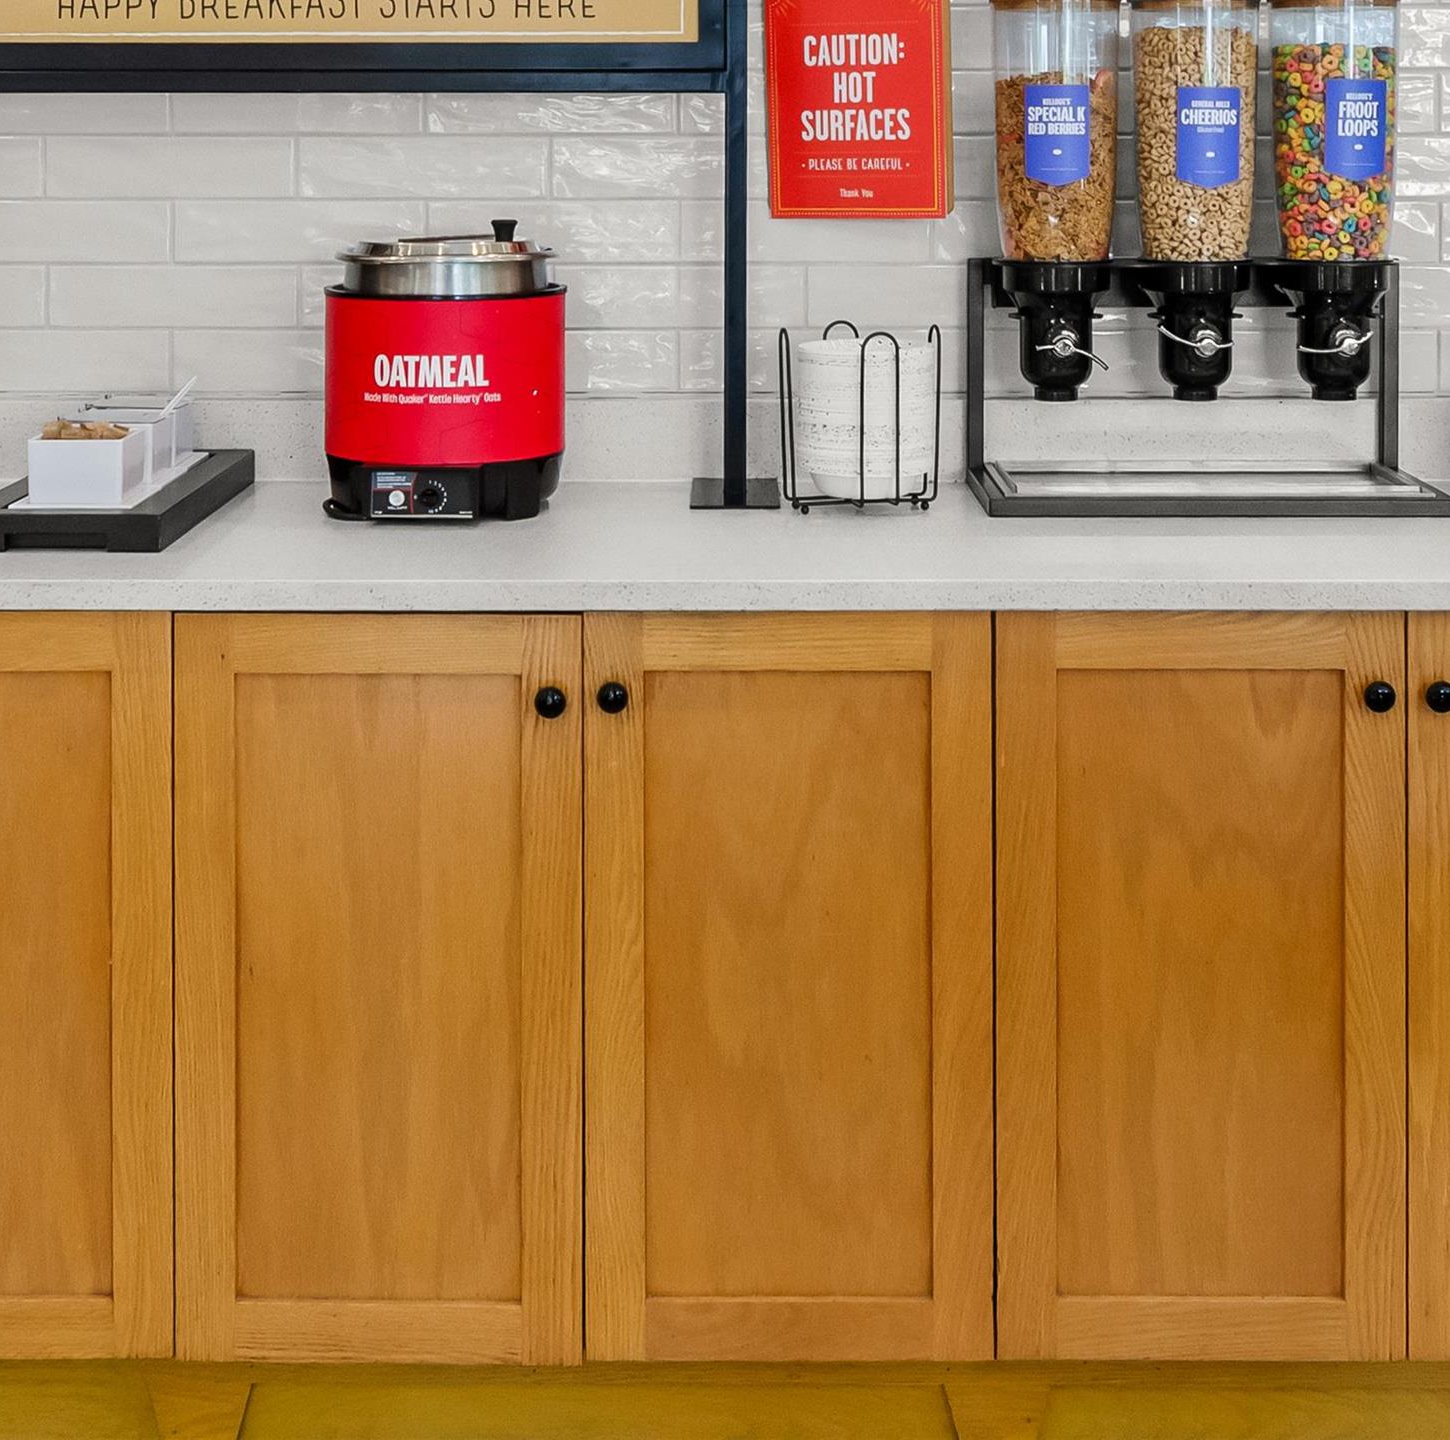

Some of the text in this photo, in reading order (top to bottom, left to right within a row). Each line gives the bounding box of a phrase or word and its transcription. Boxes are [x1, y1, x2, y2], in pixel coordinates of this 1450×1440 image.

[803, 33, 905, 67] CAUTION:
[833, 71, 876, 104] HOT
[1027, 106, 1086, 122] SPECIAL K
[1180, 108, 1238, 126] CHEERIOS
[1338, 101, 1379, 118] FROOT
[800, 108, 911, 142] SURFACES
[1027, 122, 1086, 135] RED BERRIES
[1337, 119, 1379, 137] LOOPS
[808, 158, 903, 171] PLEASE BE CAREFUL
[839, 188, 874, 198] Thank You
[374, 353, 490, 388] OATMEAL
[364, 392, 381, 402] Made
[382, 393, 398, 403] With
[429, 394, 452, 404] Kettle
[484, 392, 501, 402] Oats
